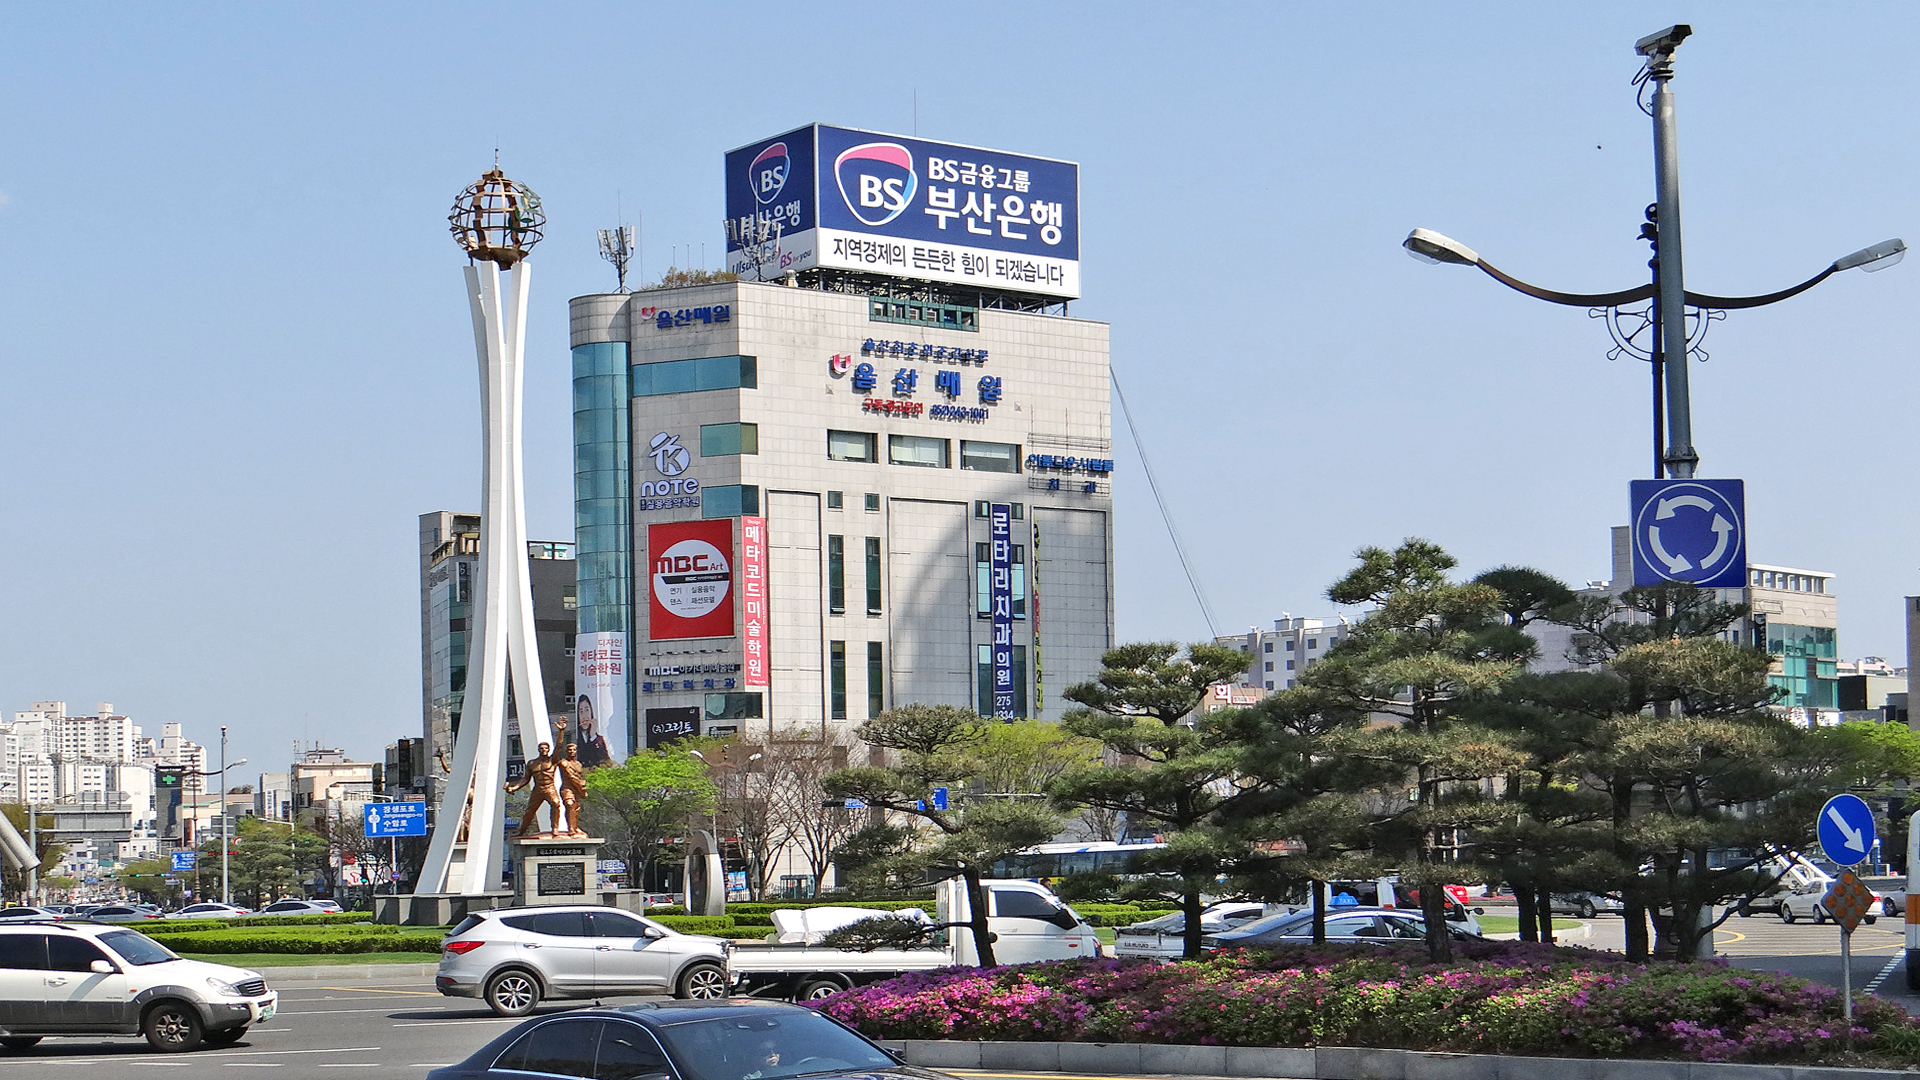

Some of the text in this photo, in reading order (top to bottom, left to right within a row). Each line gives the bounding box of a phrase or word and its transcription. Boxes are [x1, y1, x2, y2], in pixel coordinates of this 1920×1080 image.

[760, 166, 785, 193] BS
[928, 157, 1031, 193] BS금융그룹
[860, 174, 905, 211] BS
[924, 186, 1063, 246] 부산은행
[833, 238, 1064, 287] 지역경제의 든든한 힘이 되겠습니다
[656, 305, 730, 329] 울산매일
[745, 526, 762, 677] 메타코드미술학원
[993, 512, 1011, 685] 로타리치과의원
[580, 650, 622, 662] 메타코드
[597, 638, 623, 648] 디자인
[580, 662, 622, 676] 미술학원
[996, 695, 1011, 706] 275
